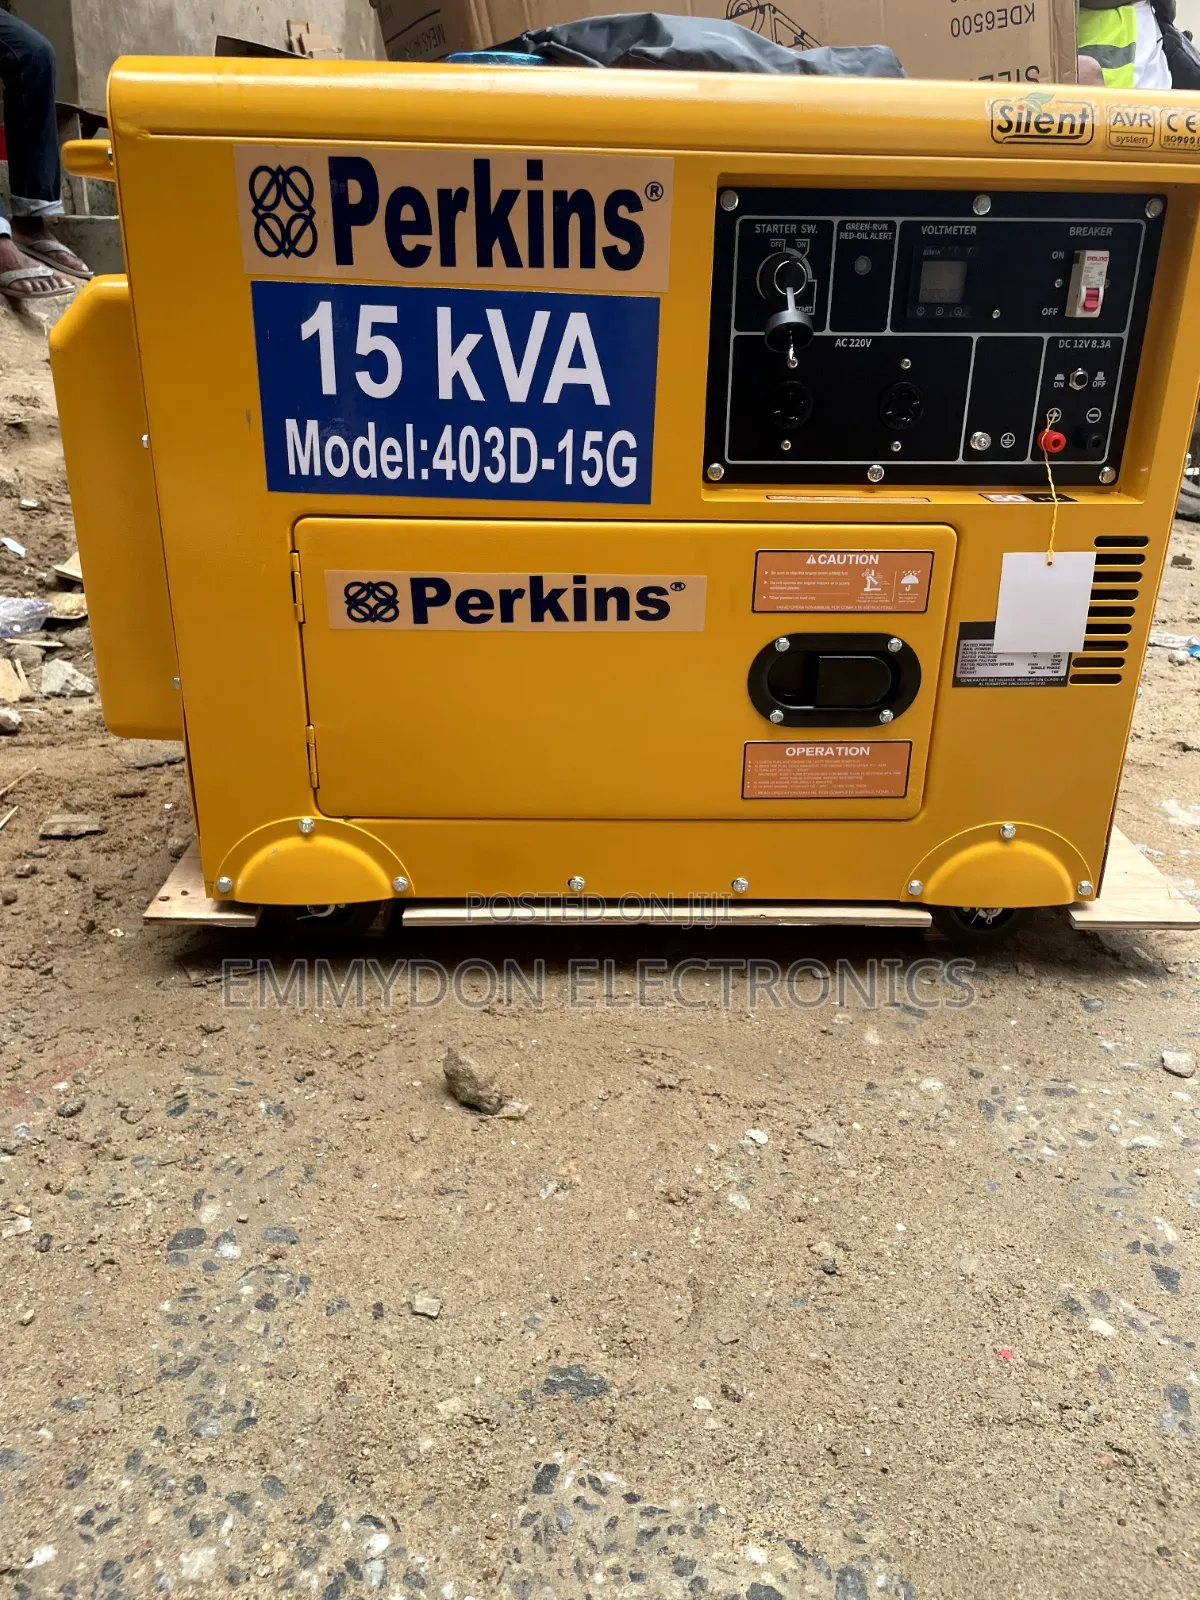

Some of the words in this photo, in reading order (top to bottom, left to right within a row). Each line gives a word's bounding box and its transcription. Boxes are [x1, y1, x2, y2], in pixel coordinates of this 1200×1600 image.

[950, 2, 1036, 38] KDE6500
[996, 104, 1090, 135] Silent
[1112, 111, 1152, 127] AVR
[1167, 113, 1197, 133] CE
[1116, 135, 1149, 145] system
[755, 224, 797, 234] STARTER
[801, 224, 818, 234] SW.
[845, 223, 889, 231] GREEN-RUN
[921, 225, 977, 236] VOLTMETER
[1069, 227, 1113, 237] BREAKER
[839, 232, 868, 240] RED-OIL
[869, 232, 893, 240] ALERT
[1052, 251, 1065, 260] ON
[1041, 308, 1058, 316] OFF
[834, 338, 848, 348] AC
[849, 338, 872, 348] 220V
[1058, 340, 1071, 349] DC
[1073, 340, 1090, 349] 12V
[1091, 340, 1111, 349] 8.3A
[300, 301, 403, 399] 15
[436, 306, 611, 406] kVA
[285, 418, 638, 488] Model:403D-15G
[817, 554, 880, 565] CAUTION
[785, 746, 870, 757] OPERATION
